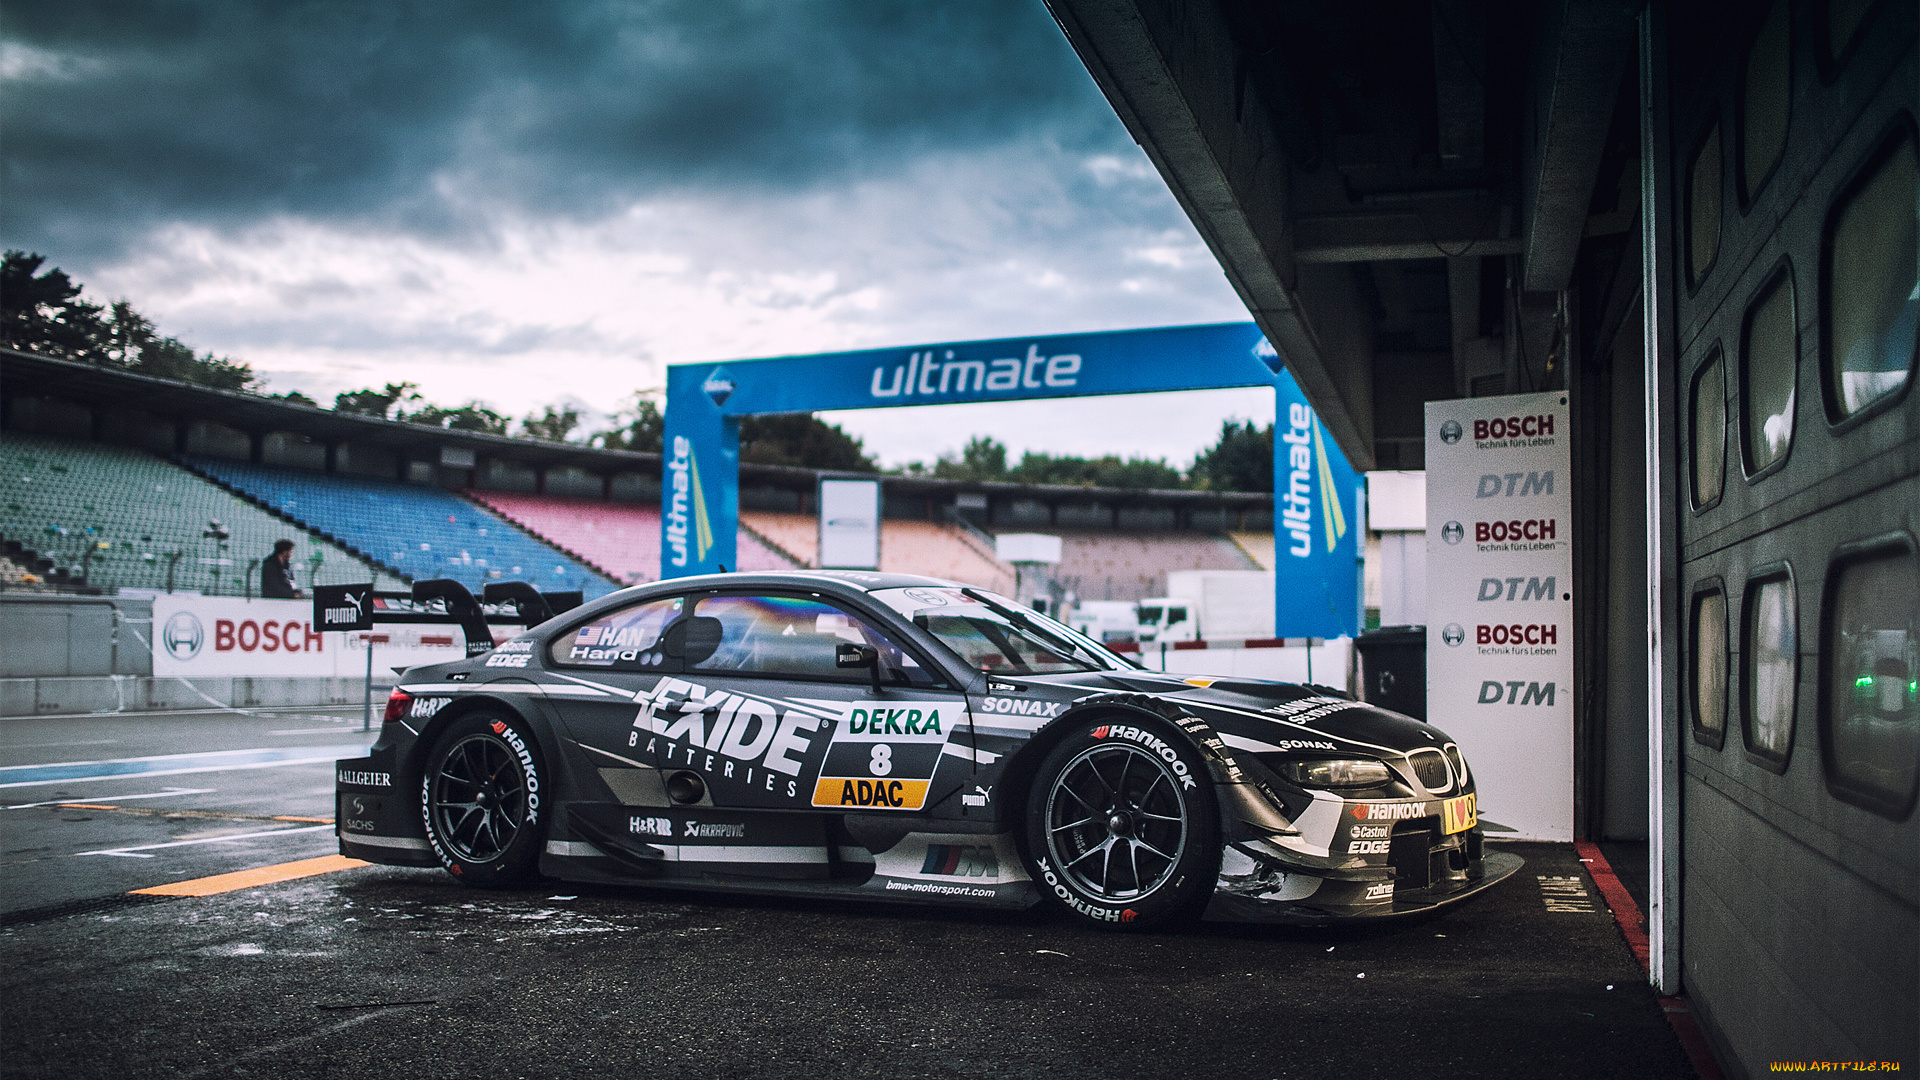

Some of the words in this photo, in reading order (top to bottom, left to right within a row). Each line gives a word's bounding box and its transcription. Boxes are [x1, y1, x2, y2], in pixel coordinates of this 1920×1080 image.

[870, 344, 1083, 398] ultimate
[1474, 414, 1554, 440] BOSCH
[1476, 440, 1508, 450] Technik
[1510, 439, 1526, 448] fürs
[1528, 437, 1555, 447] Leben
[1282, 402, 1311, 558] ultimate
[1475, 470, 1554, 498] DTM
[668, 436, 690, 568] ultimate
[1475, 519, 1555, 542] BOSCH
[1477, 543, 1508, 552] Technik
[1511, 542, 1528, 551] fürs
[1529, 541, 1555, 550] Leben
[1477, 576, 1556, 601] DTM
[325, 607, 357, 624] PUMA
[215, 620, 323, 652] BOSCH
[599, 627, 645, 647] HAN
[1476, 624, 1557, 645] BOSCH
[485, 654, 532, 668] EDGE
[569, 646, 639, 661] Hand
[1478, 646, 1509, 656] Technik
[1512, 646, 1528, 655] fürs
[1530, 646, 1557, 656] Leben
[1478, 681, 1556, 706] DTM
[981, 697, 1060, 717] SONAX
[633, 676, 821, 777] EXIDE
[849, 708, 942, 736] DEKRA
[1280, 739, 1337, 751] SONAX
[628, 731, 797, 798] BATTERIES
[869, 743, 892, 776] 8
[343, 771, 391, 786] ALLGEIER
[840, 780, 903, 807] ADAC
[962, 794, 986, 807] PUMA
[347, 819, 374, 831] SACHS
[629, 816, 657, 835] H&R
[1360, 826, 1388, 838] Castrol
[1347, 841, 1391, 854] EDGE
[886, 880, 995, 898] bmw-motorsport.com
